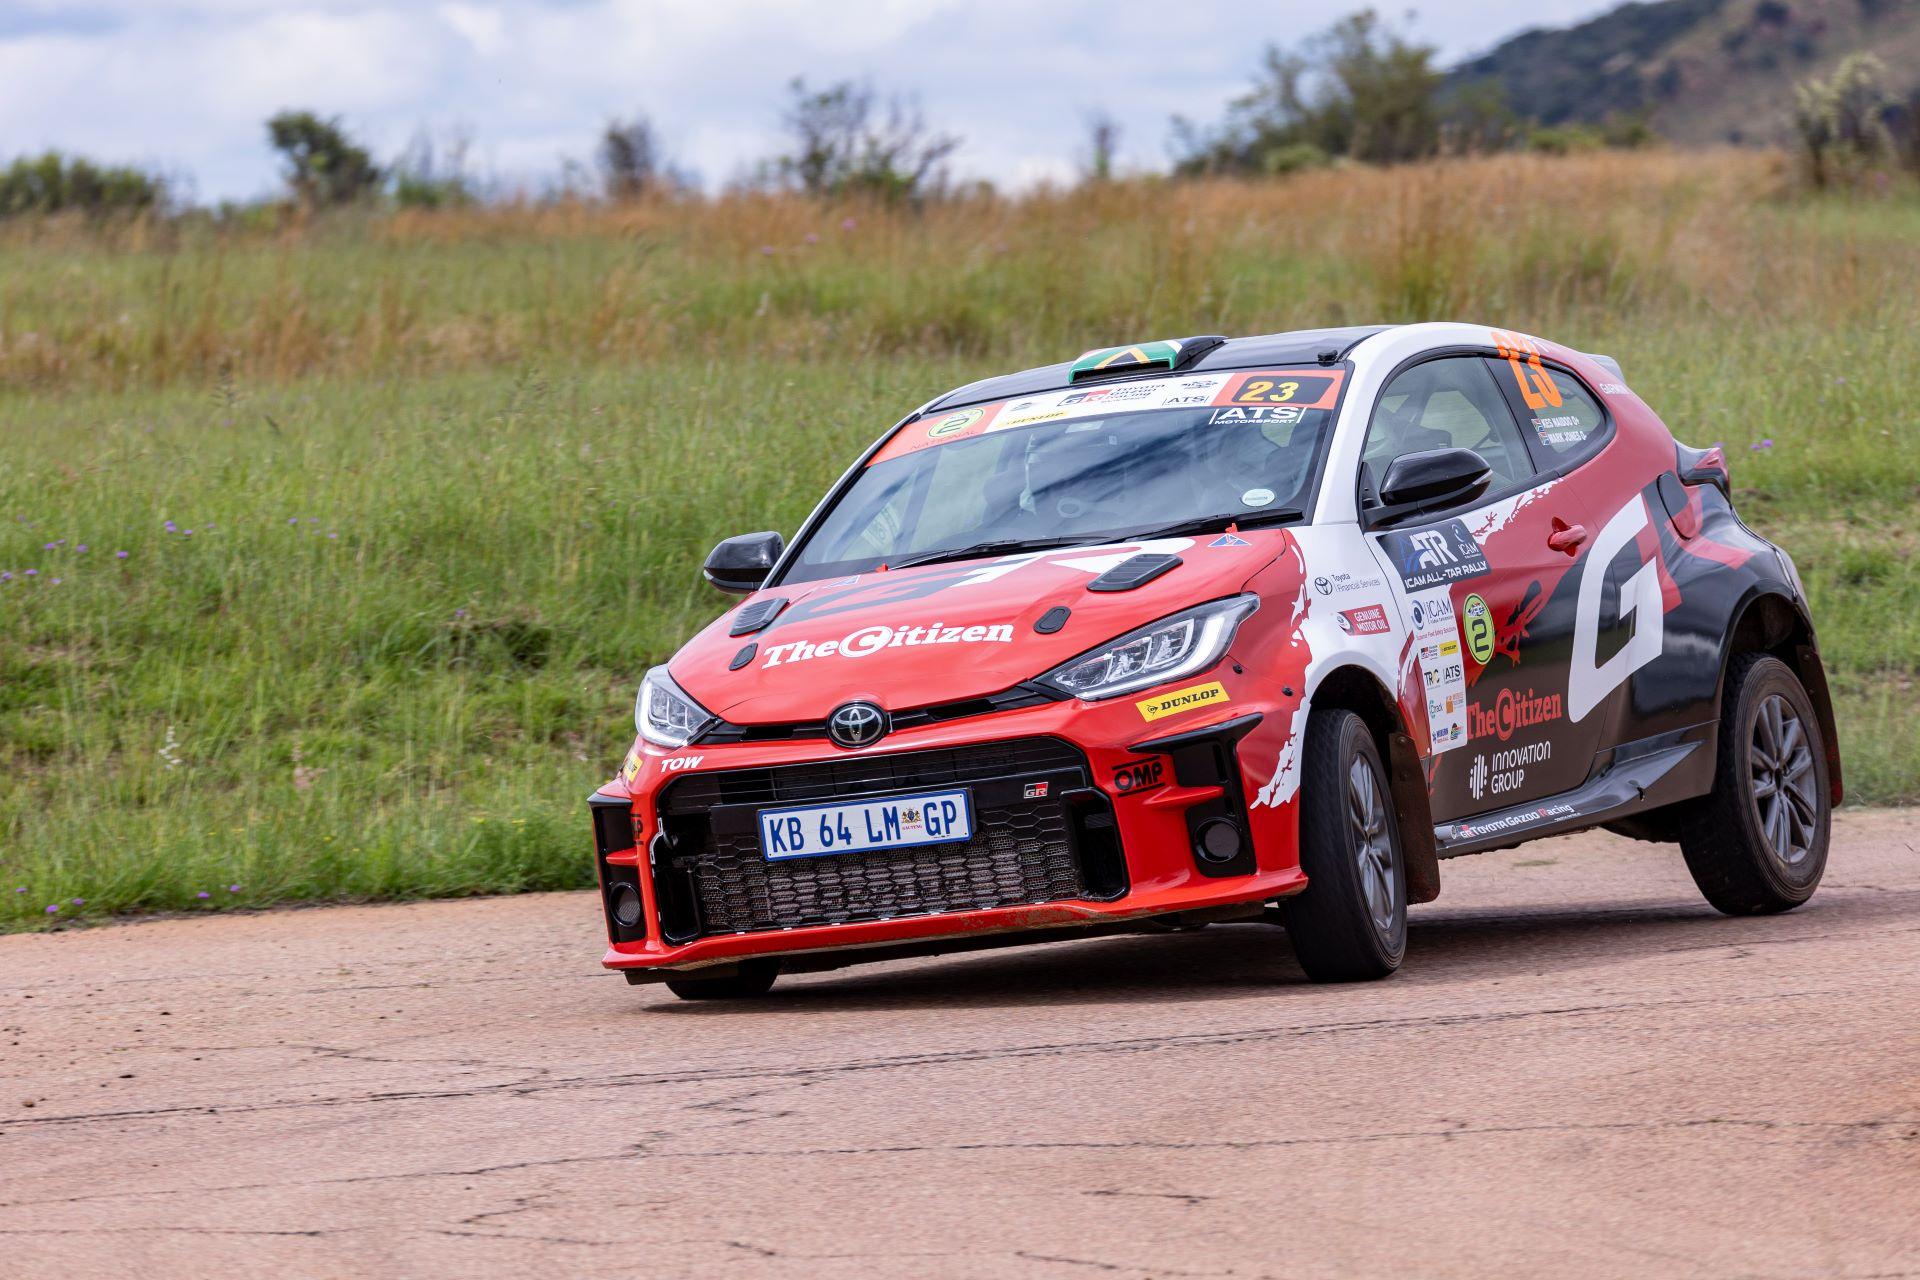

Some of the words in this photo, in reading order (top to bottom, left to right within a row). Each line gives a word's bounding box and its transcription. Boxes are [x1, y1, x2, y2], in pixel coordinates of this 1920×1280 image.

[1168, 395, 1205, 403] ATS
[1238, 381, 1299, 402] 23
[1217, 406, 1299, 420] ATS
[1331, 573, 1351, 583] Toyota
[1426, 567, 1463, 583] ALL-TAR
[1462, 560, 1488, 574] RALLY
[1336, 582, 1361, 592] Financial
[1360, 579, 1380, 588] Services
[1353, 608, 1382, 622] GENUINE
[1356, 620, 1378, 632] MOTOR
[1376, 619, 1388, 629] OIL
[1472, 619, 1490, 653] 2
[1445, 664, 1461, 679] ATS
[1161, 689, 1219, 711] DUNLOP
[661, 756, 704, 773] TOW
[1492, 740, 1551, 772] INNOVATION
[1114, 762, 1163, 791] OMP
[1491, 769, 1525, 795] GROUP
[769, 816, 804, 853] KB
[819, 812, 852, 848] 64
[865, 806, 901, 843] LM
[923, 800, 957, 836] GP
[1472, 820, 1506, 835] TOYOTA
[1507, 811, 1540, 826] GAZOO
[1538, 804, 1575, 818] Racing
